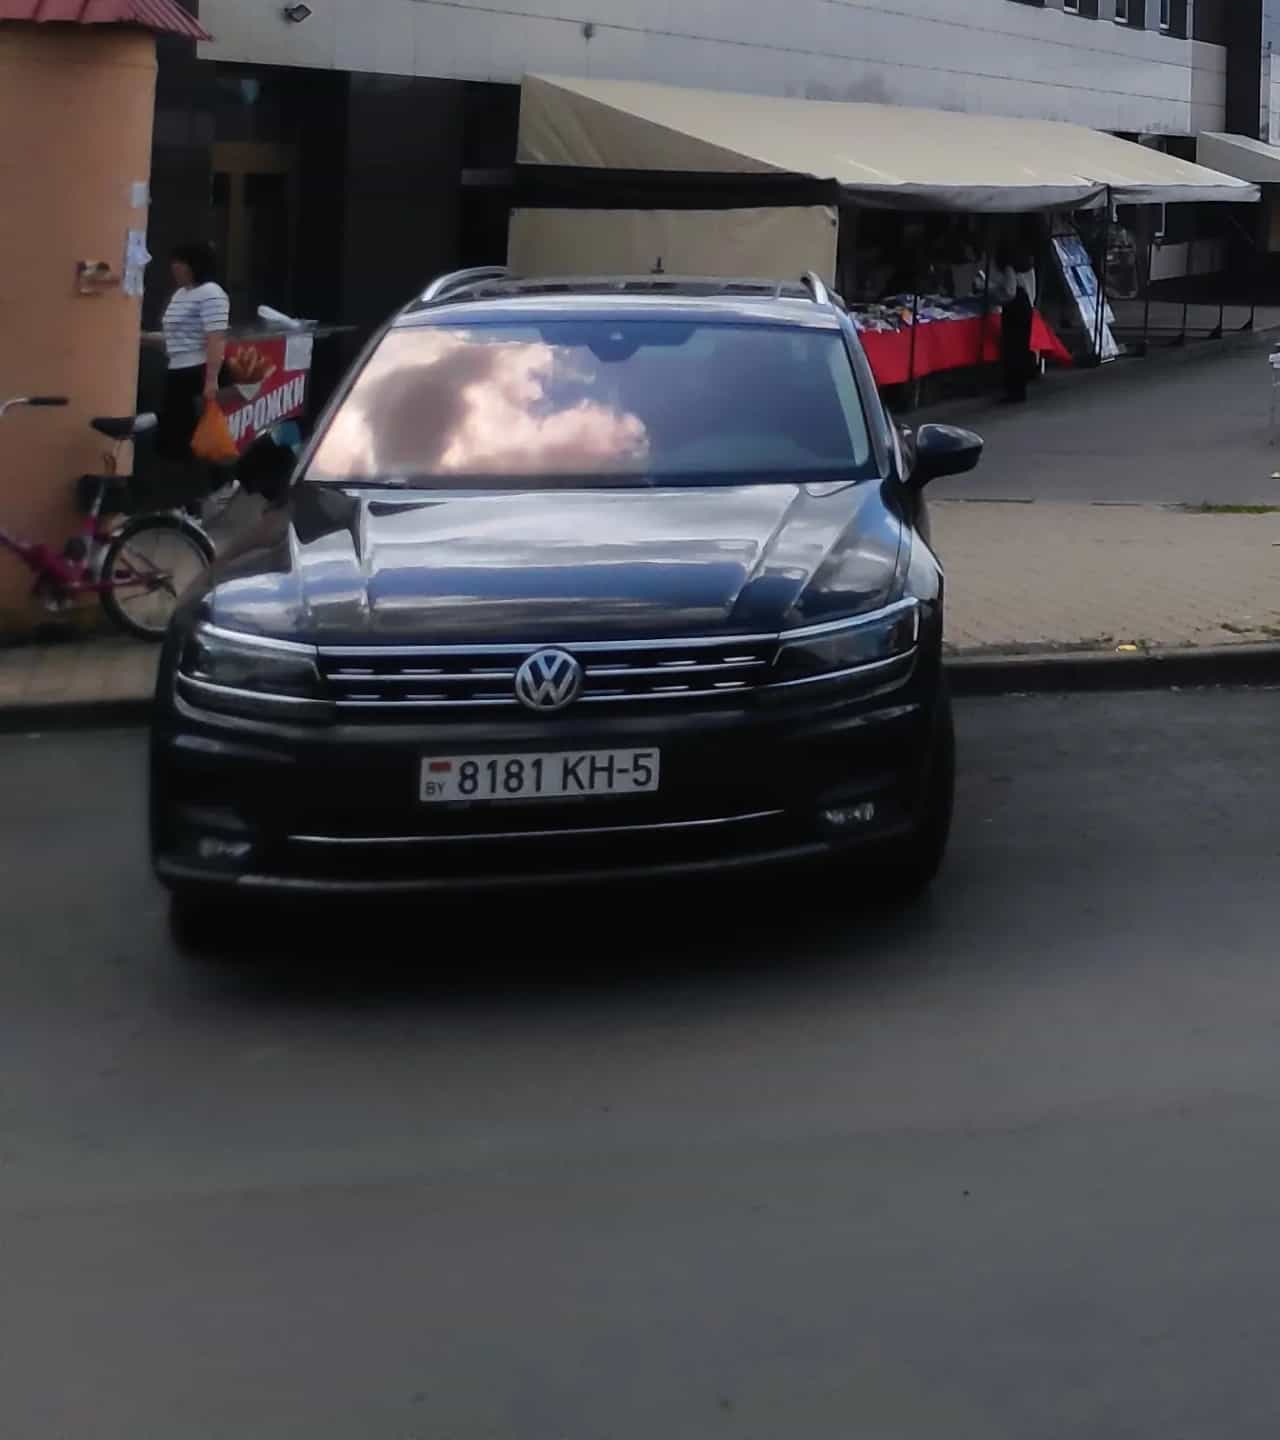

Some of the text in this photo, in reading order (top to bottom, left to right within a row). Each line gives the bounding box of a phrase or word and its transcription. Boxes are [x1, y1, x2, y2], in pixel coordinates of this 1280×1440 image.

[228, 373, 305, 439] ИРОЖКИ
[425, 752, 653, 796] BY 8181 KH-5
